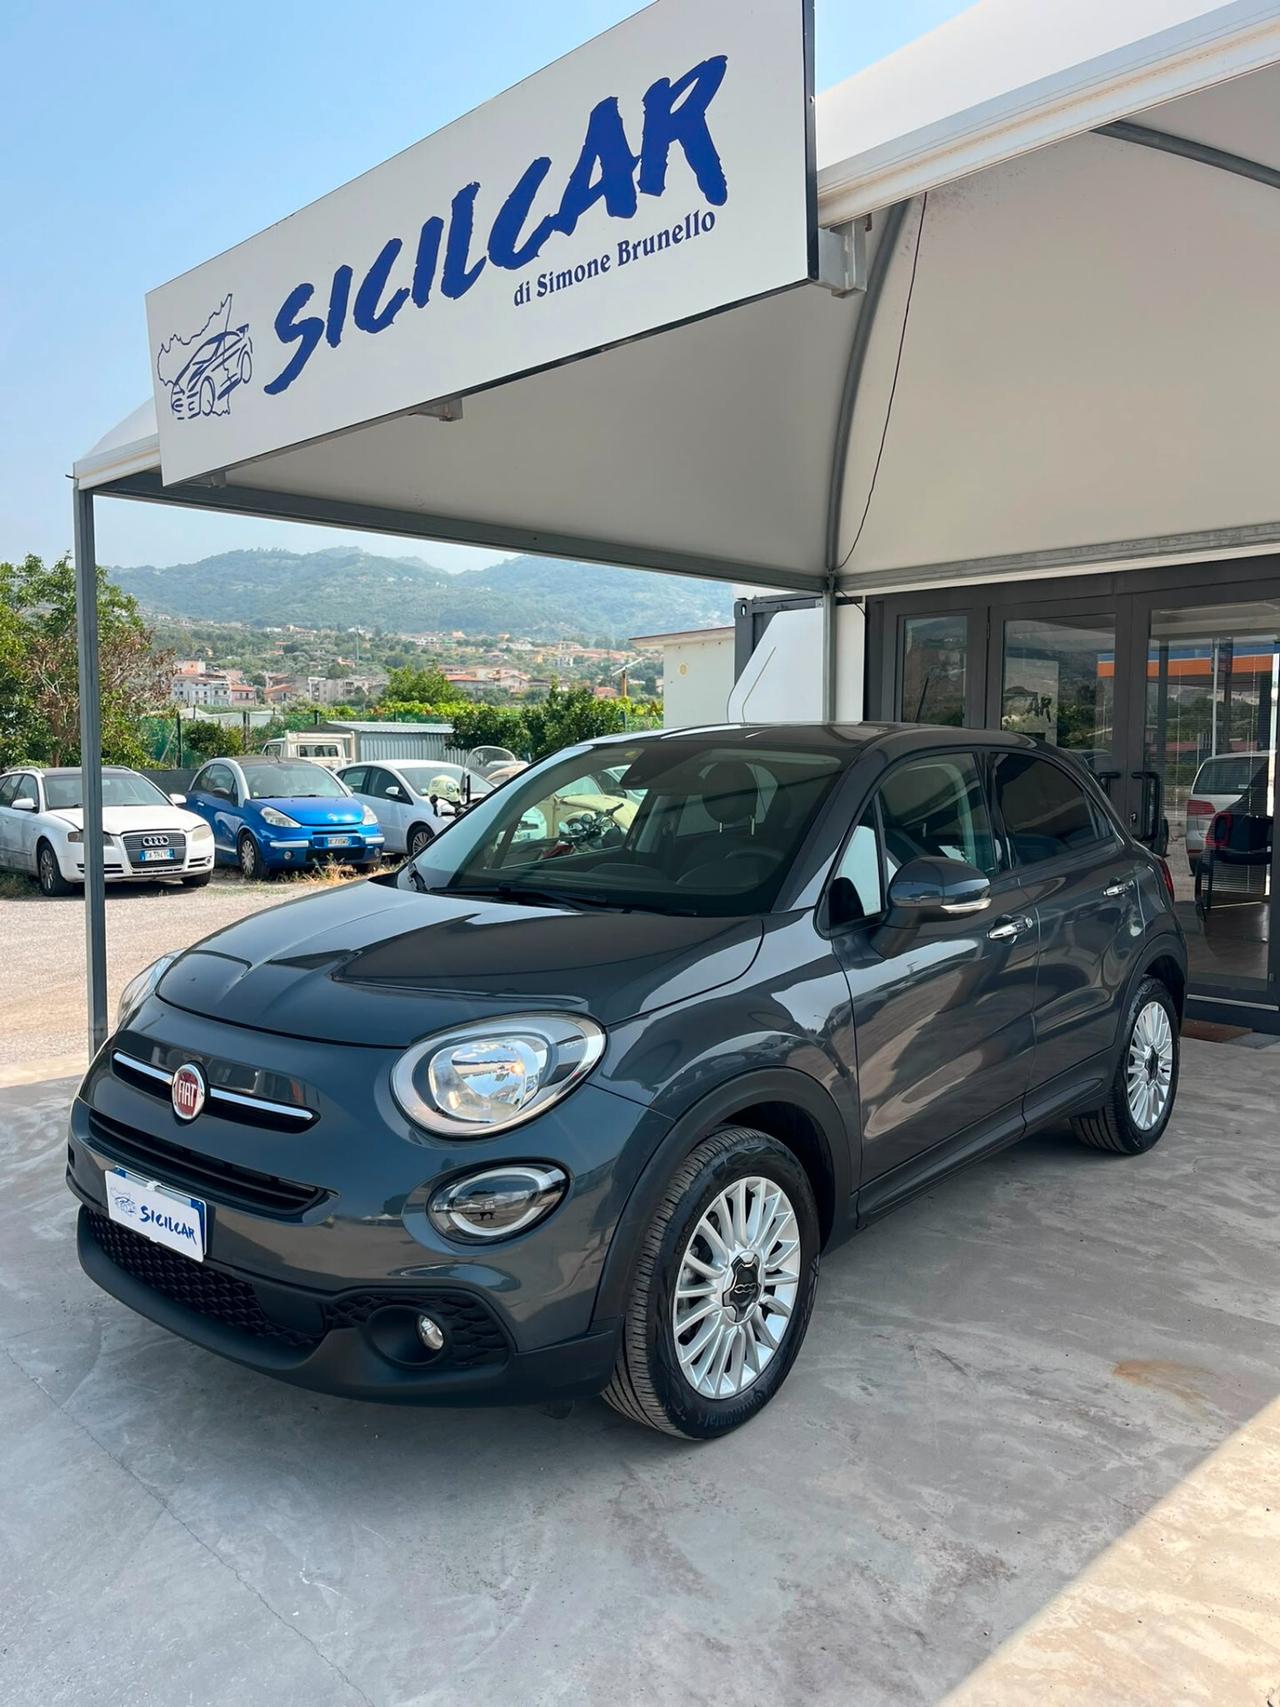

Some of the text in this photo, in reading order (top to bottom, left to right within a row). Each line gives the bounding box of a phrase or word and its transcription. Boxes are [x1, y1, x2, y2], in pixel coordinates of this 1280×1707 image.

[265, 55, 728, 394] SICILCAR
[514, 209, 716, 306] di Simone Brunello
[178, 1080, 198, 1107] FIAT
[139, 1205, 198, 1246] SICILCAR
